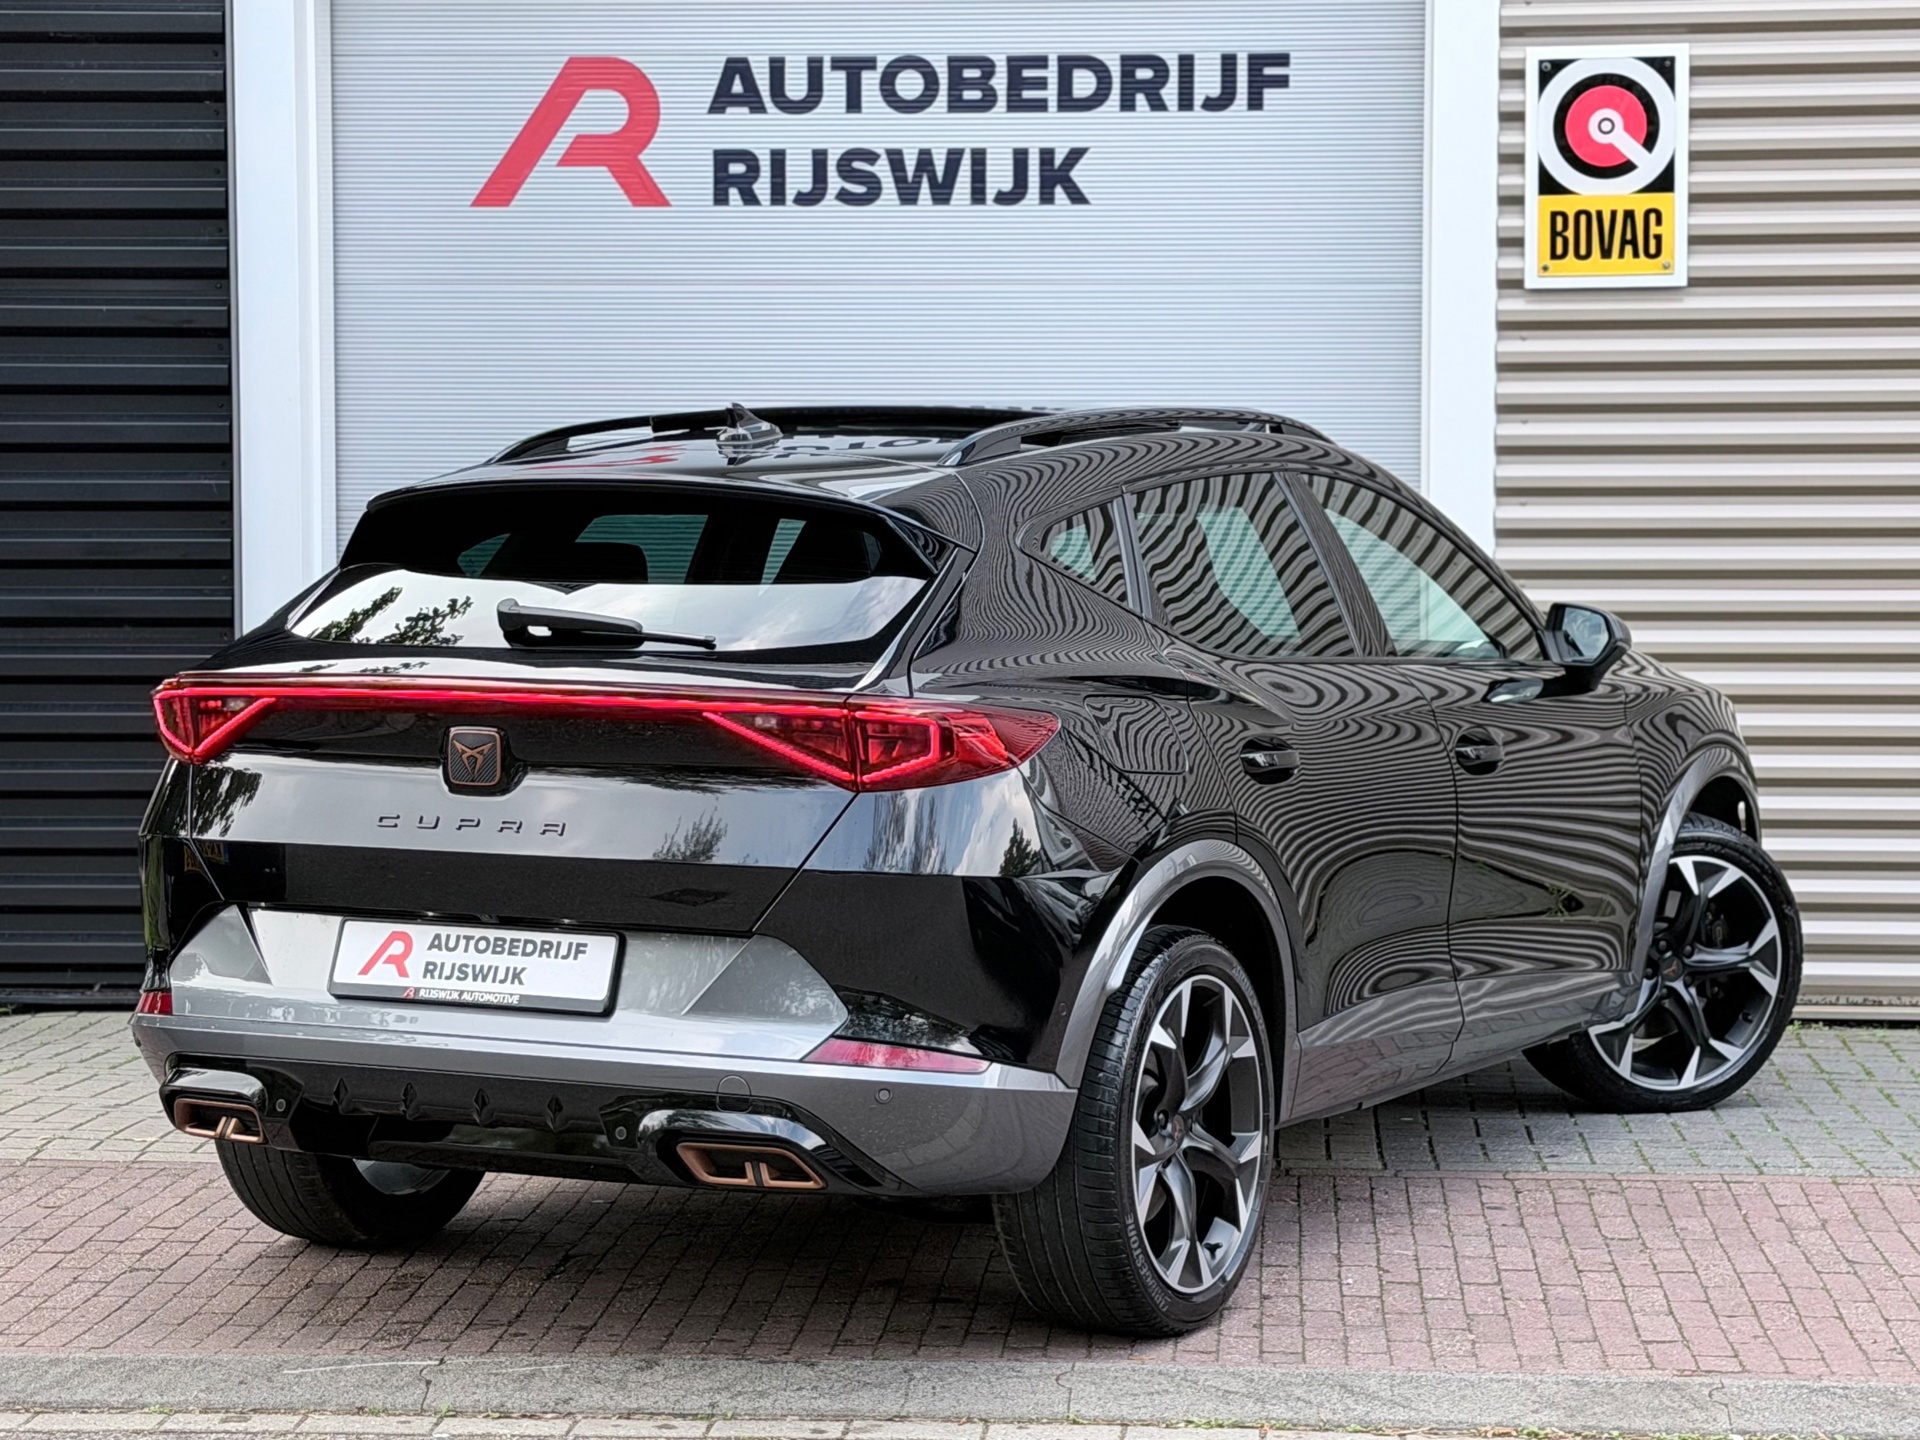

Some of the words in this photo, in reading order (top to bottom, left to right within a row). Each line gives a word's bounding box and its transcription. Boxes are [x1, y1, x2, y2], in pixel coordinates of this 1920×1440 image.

[708, 53, 1290, 115] AUTOBEDRIJF
[713, 147, 1090, 207] RIJSWIJK
[1549, 207, 1663, 261] BOVAG
[377, 813, 566, 837] CUPRA
[427, 932, 588, 961] AUTOBEDRIJF
[422, 961, 528, 986] RIJSWIJK
[419, 988, 460, 1000] RIJSWIJK
[461, 991, 520, 1004] AUTOMOTIVE
